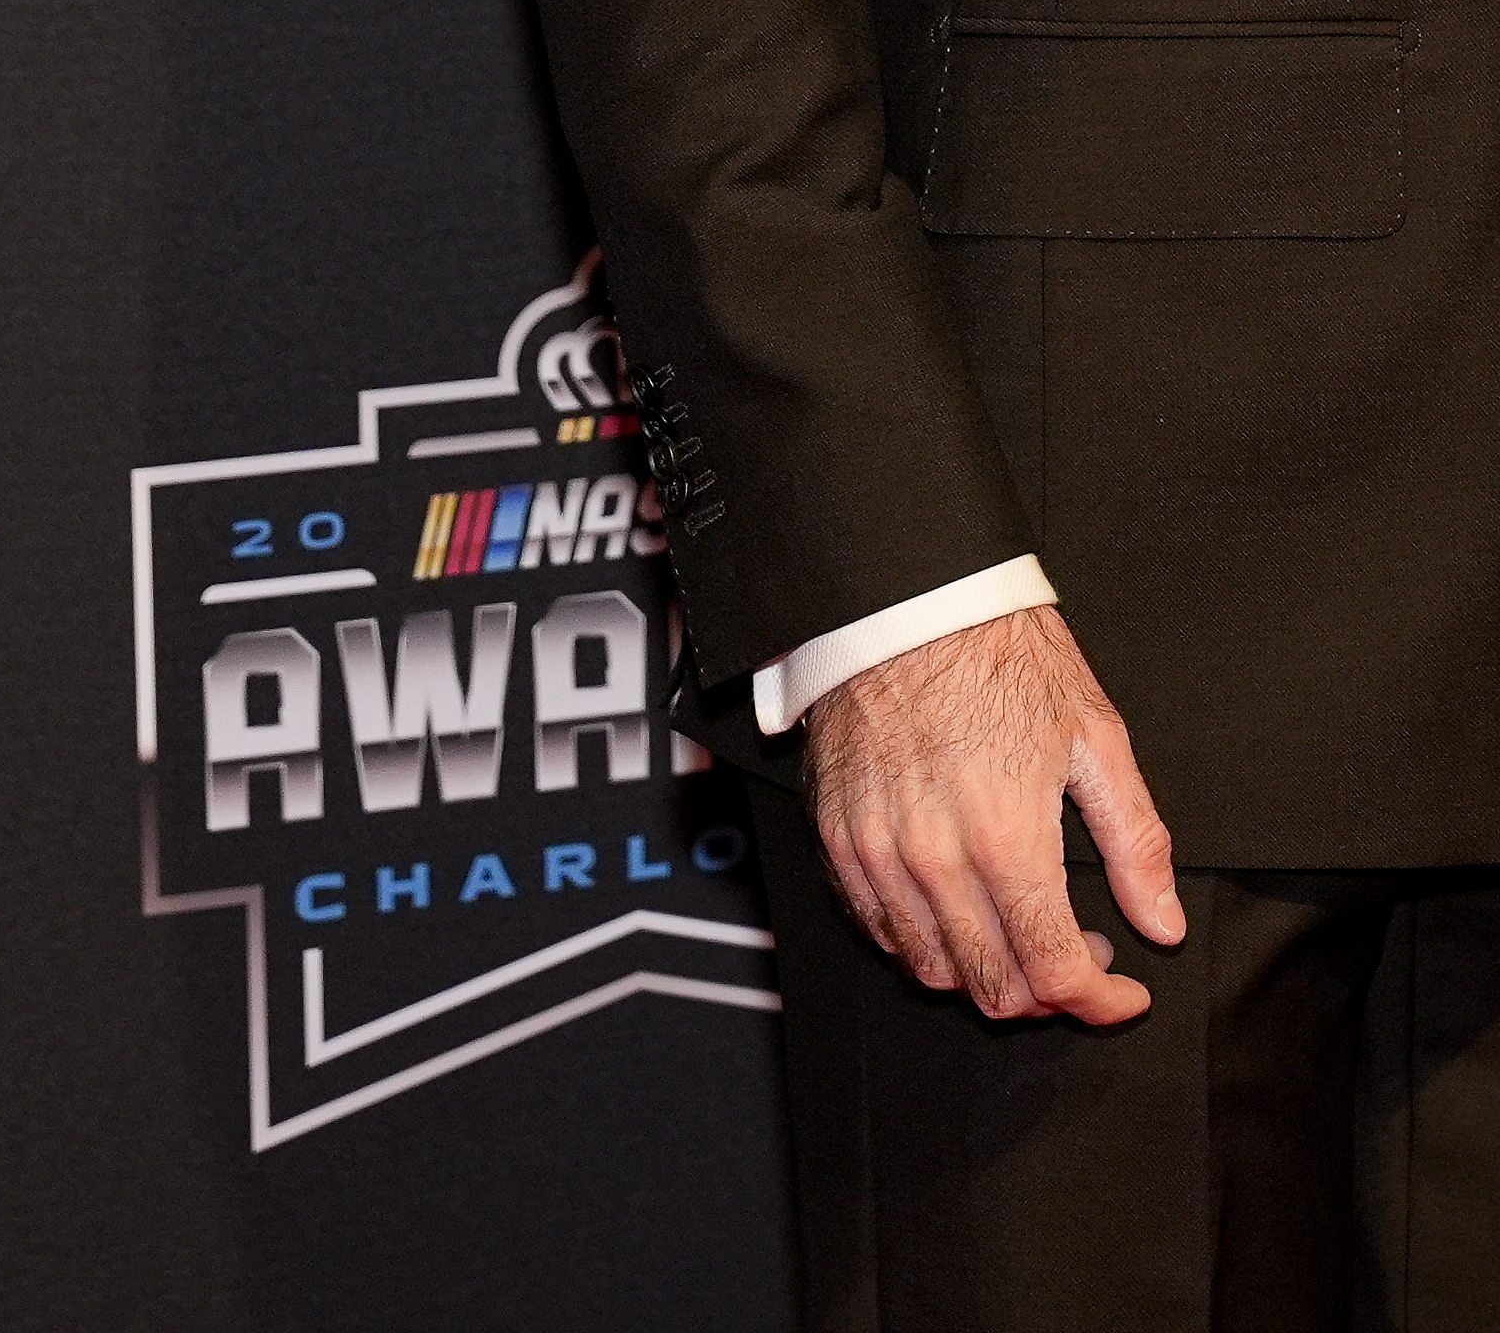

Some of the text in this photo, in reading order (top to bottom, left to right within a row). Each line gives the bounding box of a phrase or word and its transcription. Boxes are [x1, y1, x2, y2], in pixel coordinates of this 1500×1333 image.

[232, 510, 347, 559] 20
[201, 589, 713, 833] AWA
[294, 825, 748, 923] CHARLO
